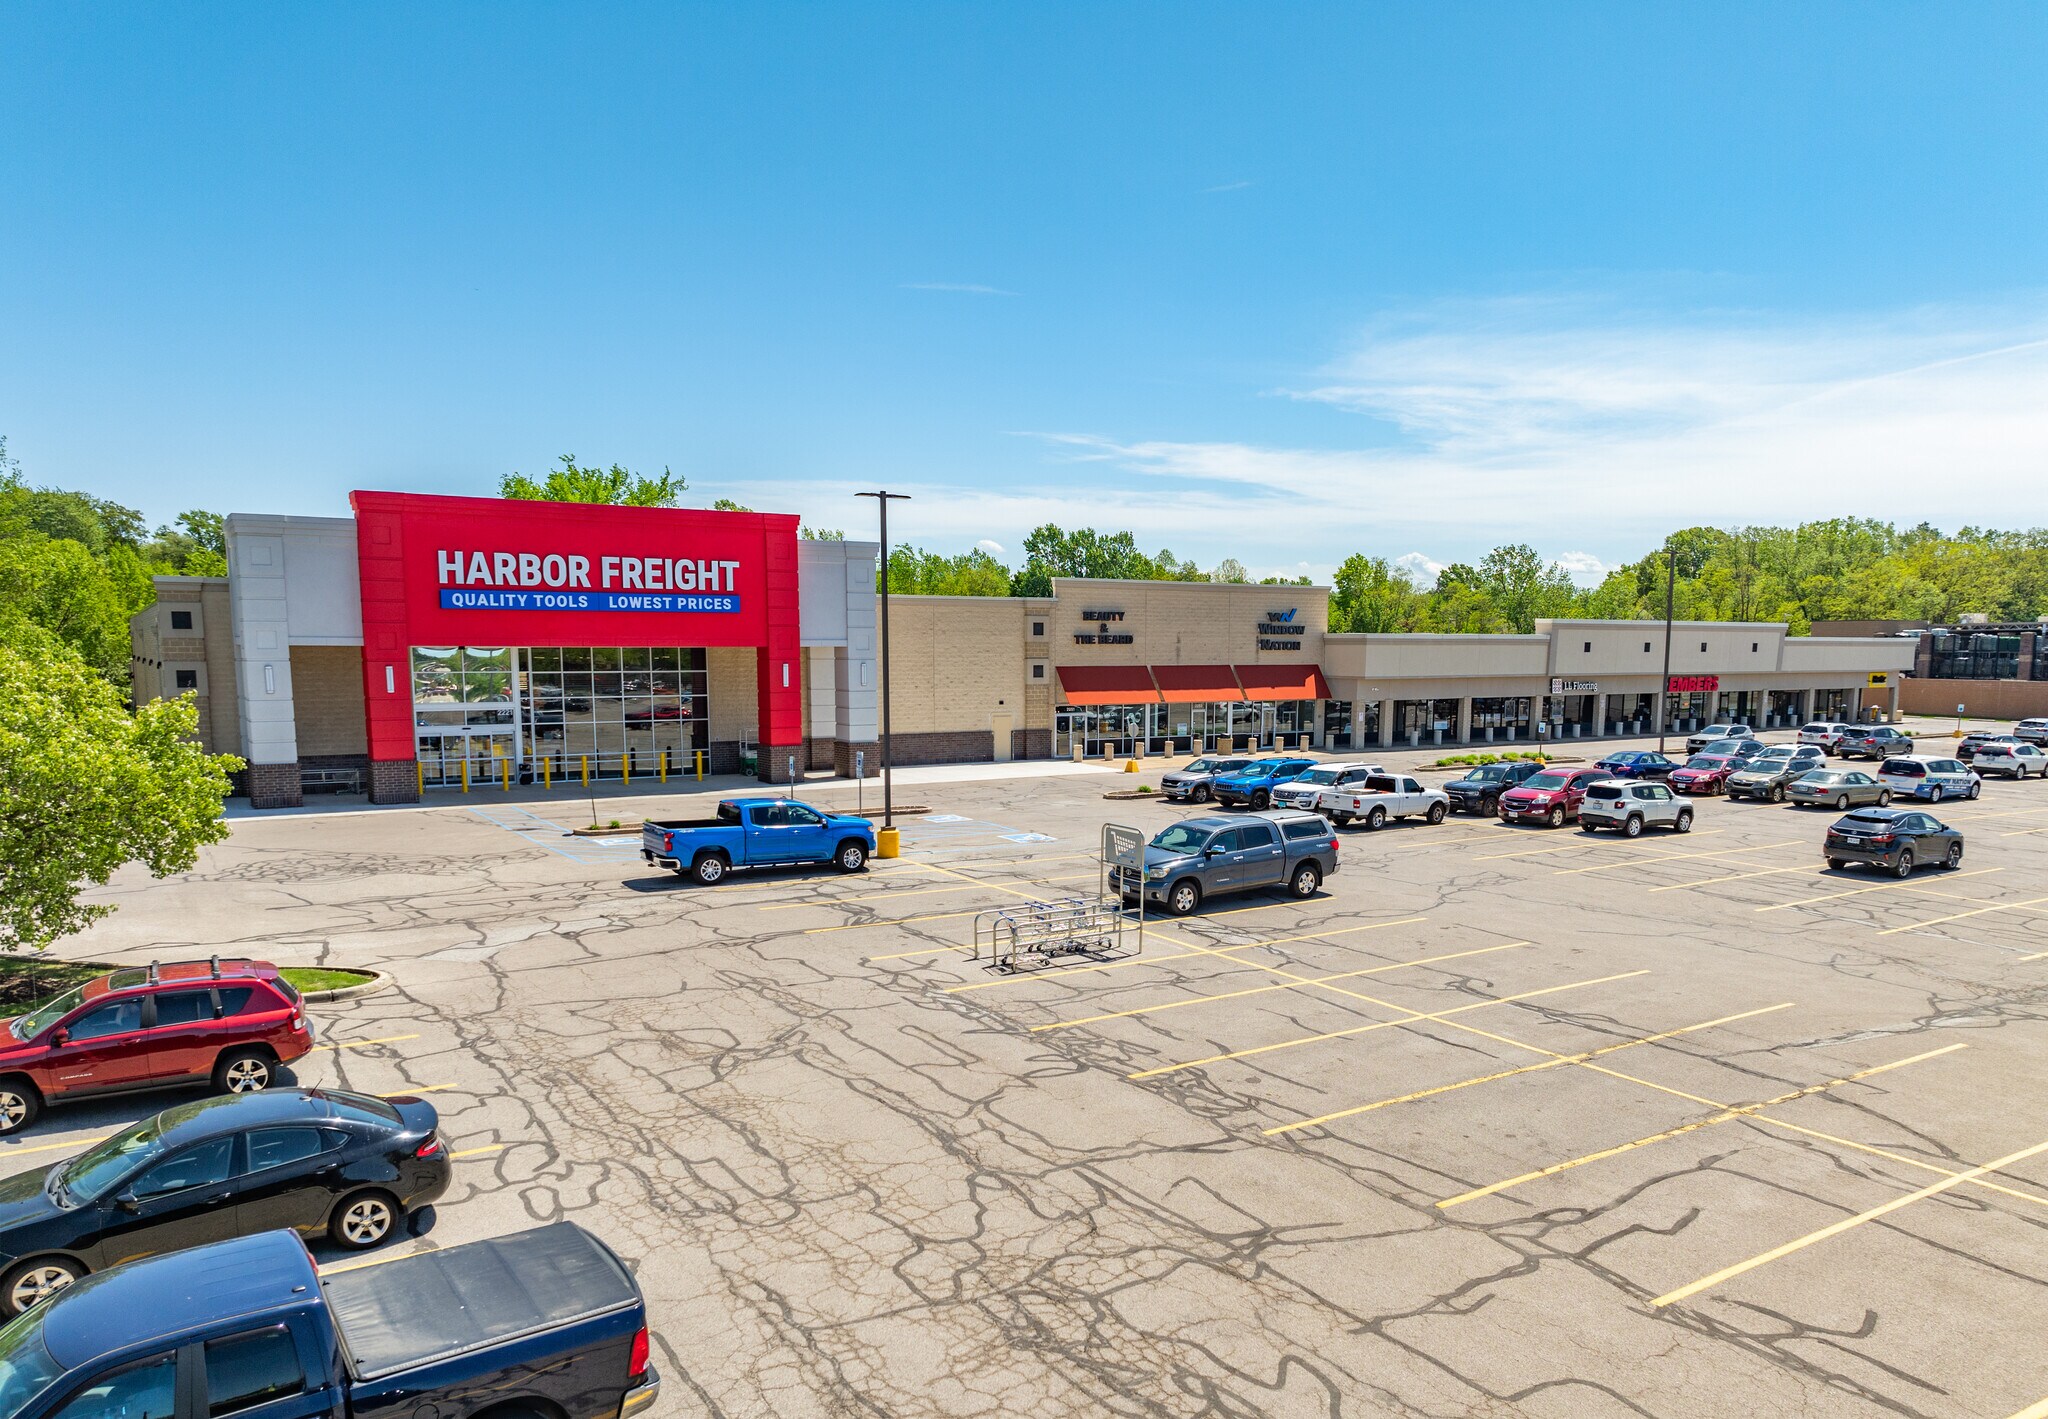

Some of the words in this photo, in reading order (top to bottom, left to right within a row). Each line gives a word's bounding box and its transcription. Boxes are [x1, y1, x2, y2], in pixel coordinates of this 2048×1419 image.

[437, 550, 592, 588] HARBOR
[601, 556, 740, 591] FREIGHT
[451, 593, 528, 608] QUALITY
[533, 594, 588, 608] TOOLS
[608, 596, 672, 609] LOWEST
[677, 598, 732, 610] PRICES
[1082, 611, 1125, 621] BEAUTY
[1099, 623, 1108, 633] &
[1074, 634, 1096, 645] THE
[1097, 634, 1134, 645] BEARD
[1573, 681, 1598, 692] Flooring
[1668, 676, 1719, 692] EMBERS
